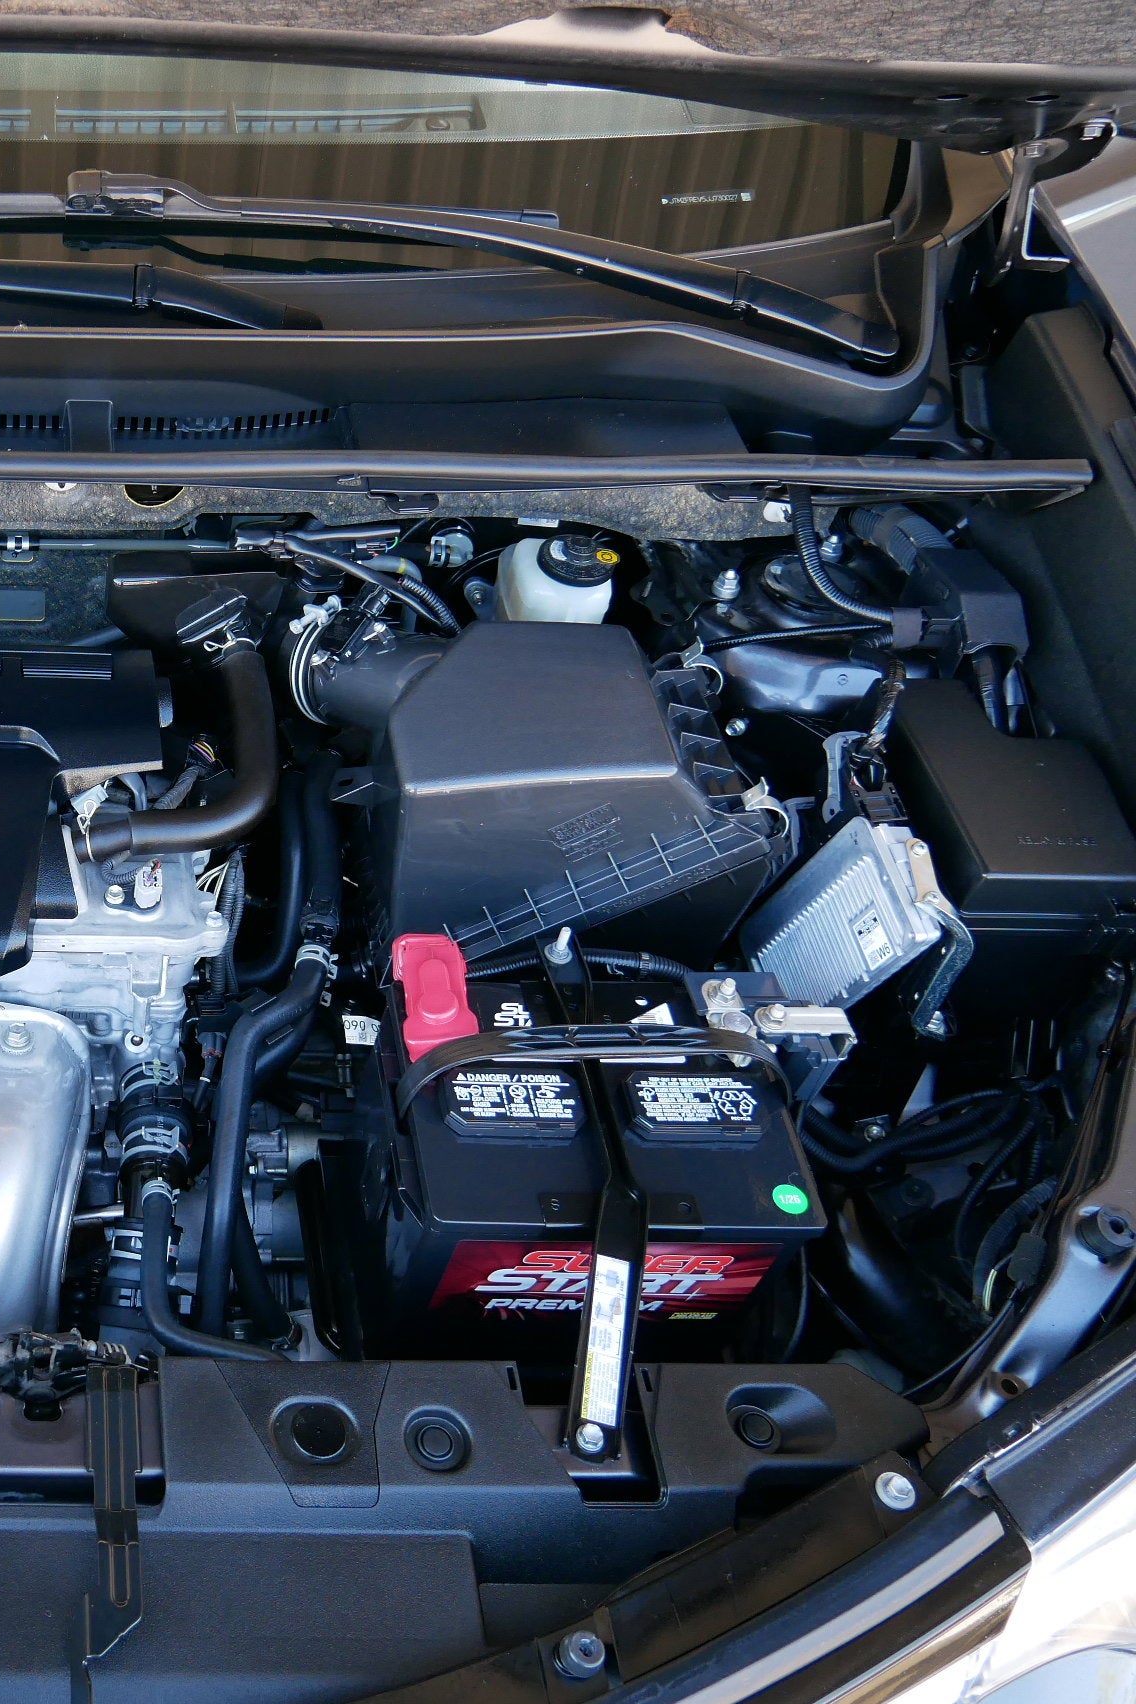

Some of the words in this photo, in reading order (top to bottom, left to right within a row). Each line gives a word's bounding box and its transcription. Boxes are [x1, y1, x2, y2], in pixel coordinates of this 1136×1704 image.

[466, 1073, 512, 1083] DANGER
[521, 1074, 561, 1083] POISON
[513, 1250, 735, 1275] SUER
[484, 1298, 665, 1311] PREMM
